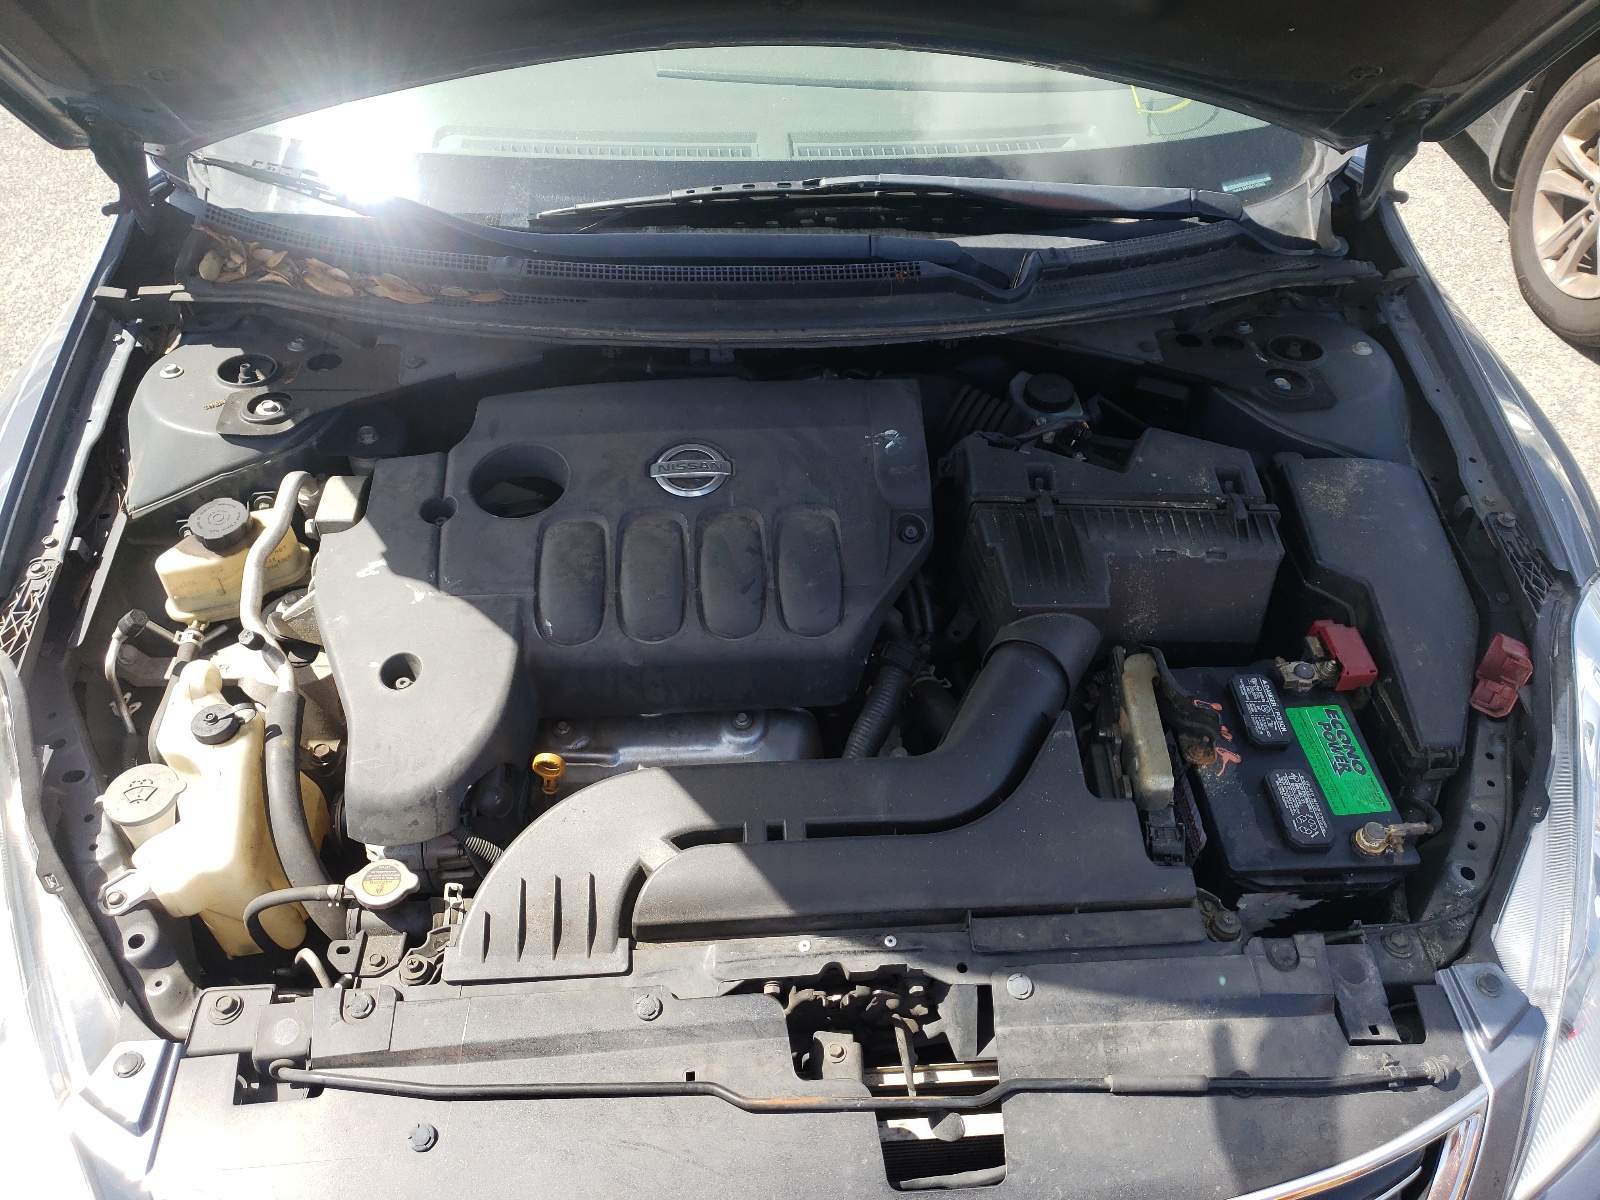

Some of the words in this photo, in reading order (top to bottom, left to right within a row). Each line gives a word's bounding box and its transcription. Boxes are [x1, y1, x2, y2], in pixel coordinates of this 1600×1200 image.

[658, 461, 723, 473] NISSAN
[1316, 721, 1352, 778] POWER
[1323, 707, 1367, 776] ECONO
